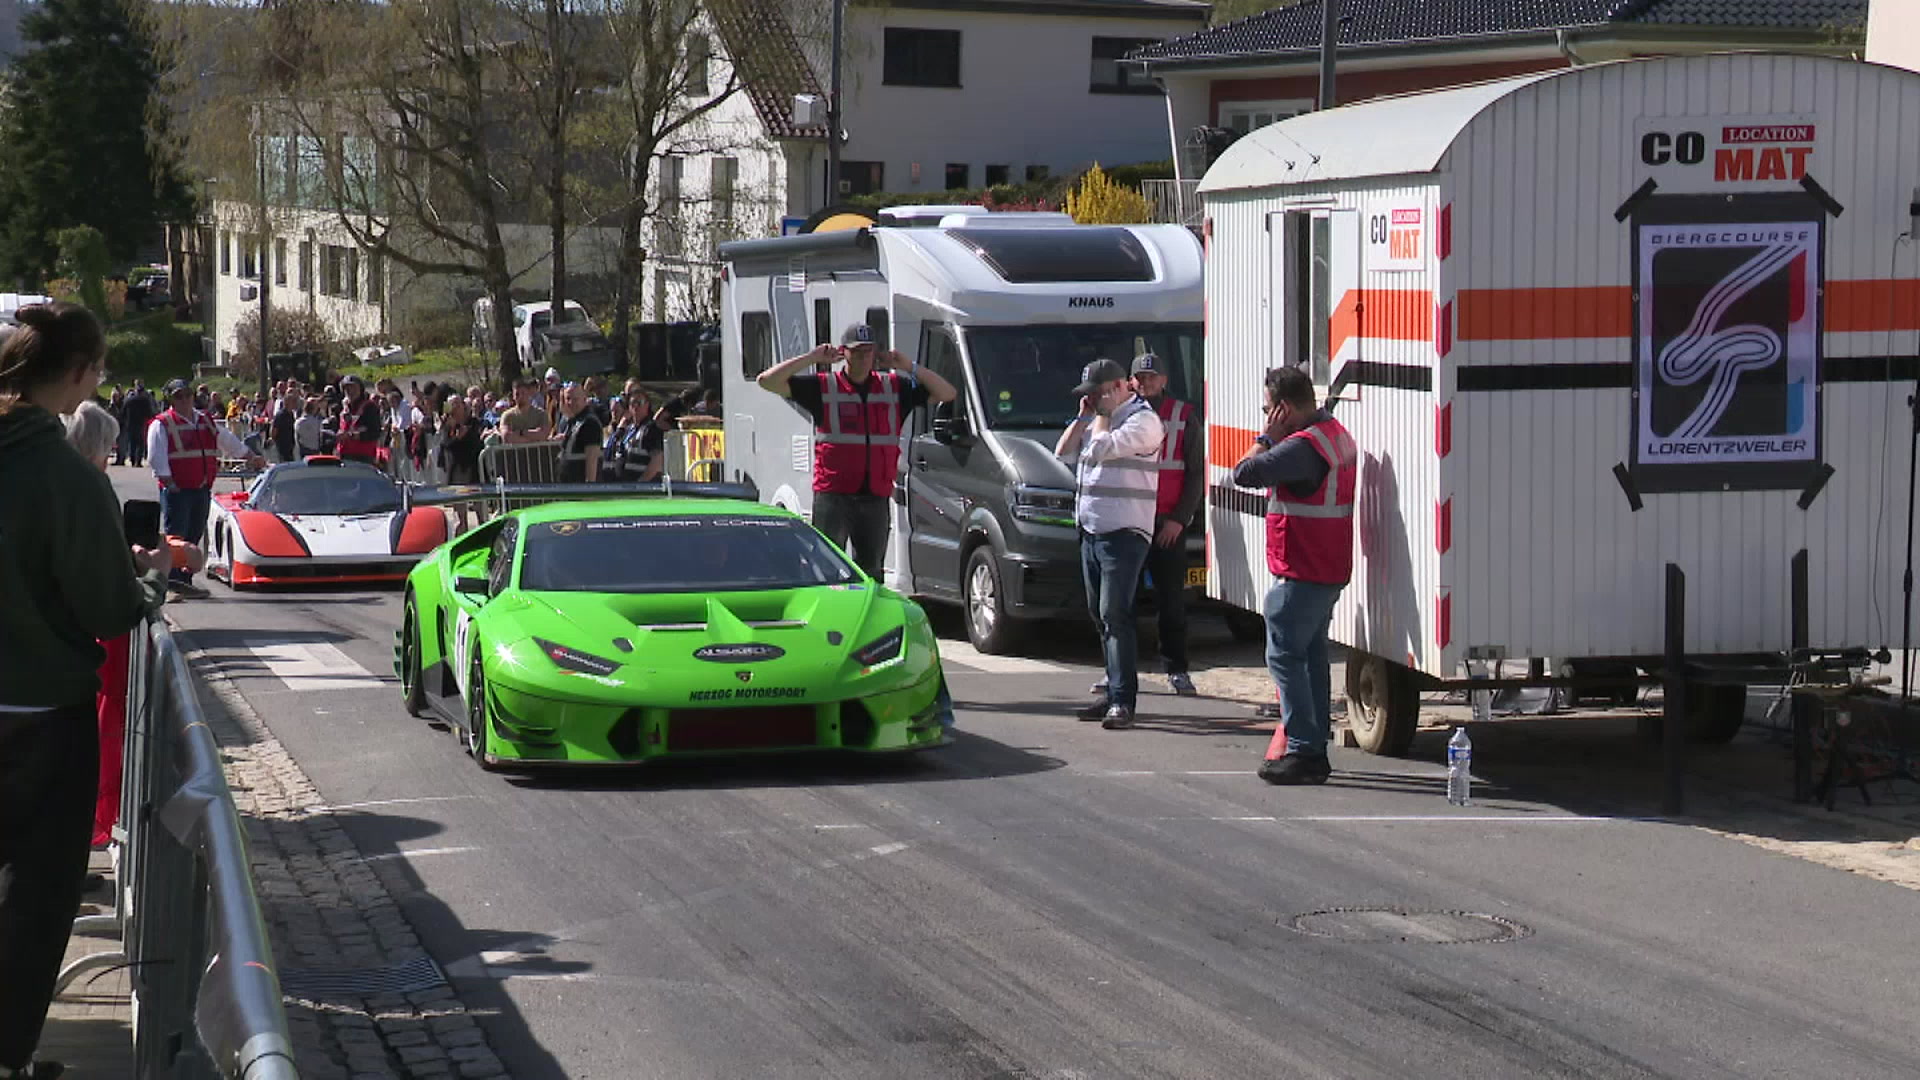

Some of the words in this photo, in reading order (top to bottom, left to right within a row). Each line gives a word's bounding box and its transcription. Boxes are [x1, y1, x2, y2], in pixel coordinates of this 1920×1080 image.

[1729, 128, 1808, 141] LOCATION
[1641, 132, 1705, 166] CO
[1714, 147, 1813, 182] MAT
[1371, 215, 1387, 244] CO
[1651, 231, 1809, 245] BIERGCOURSE
[1389, 229, 1420, 259] MAT
[1068, 296, 1115, 309] KNAUS
[1647, 439, 1807, 456] LORENTZWEILER
[689, 688, 733, 702] HERZOG
[735, 686, 808, 699] MOTORSPORT
